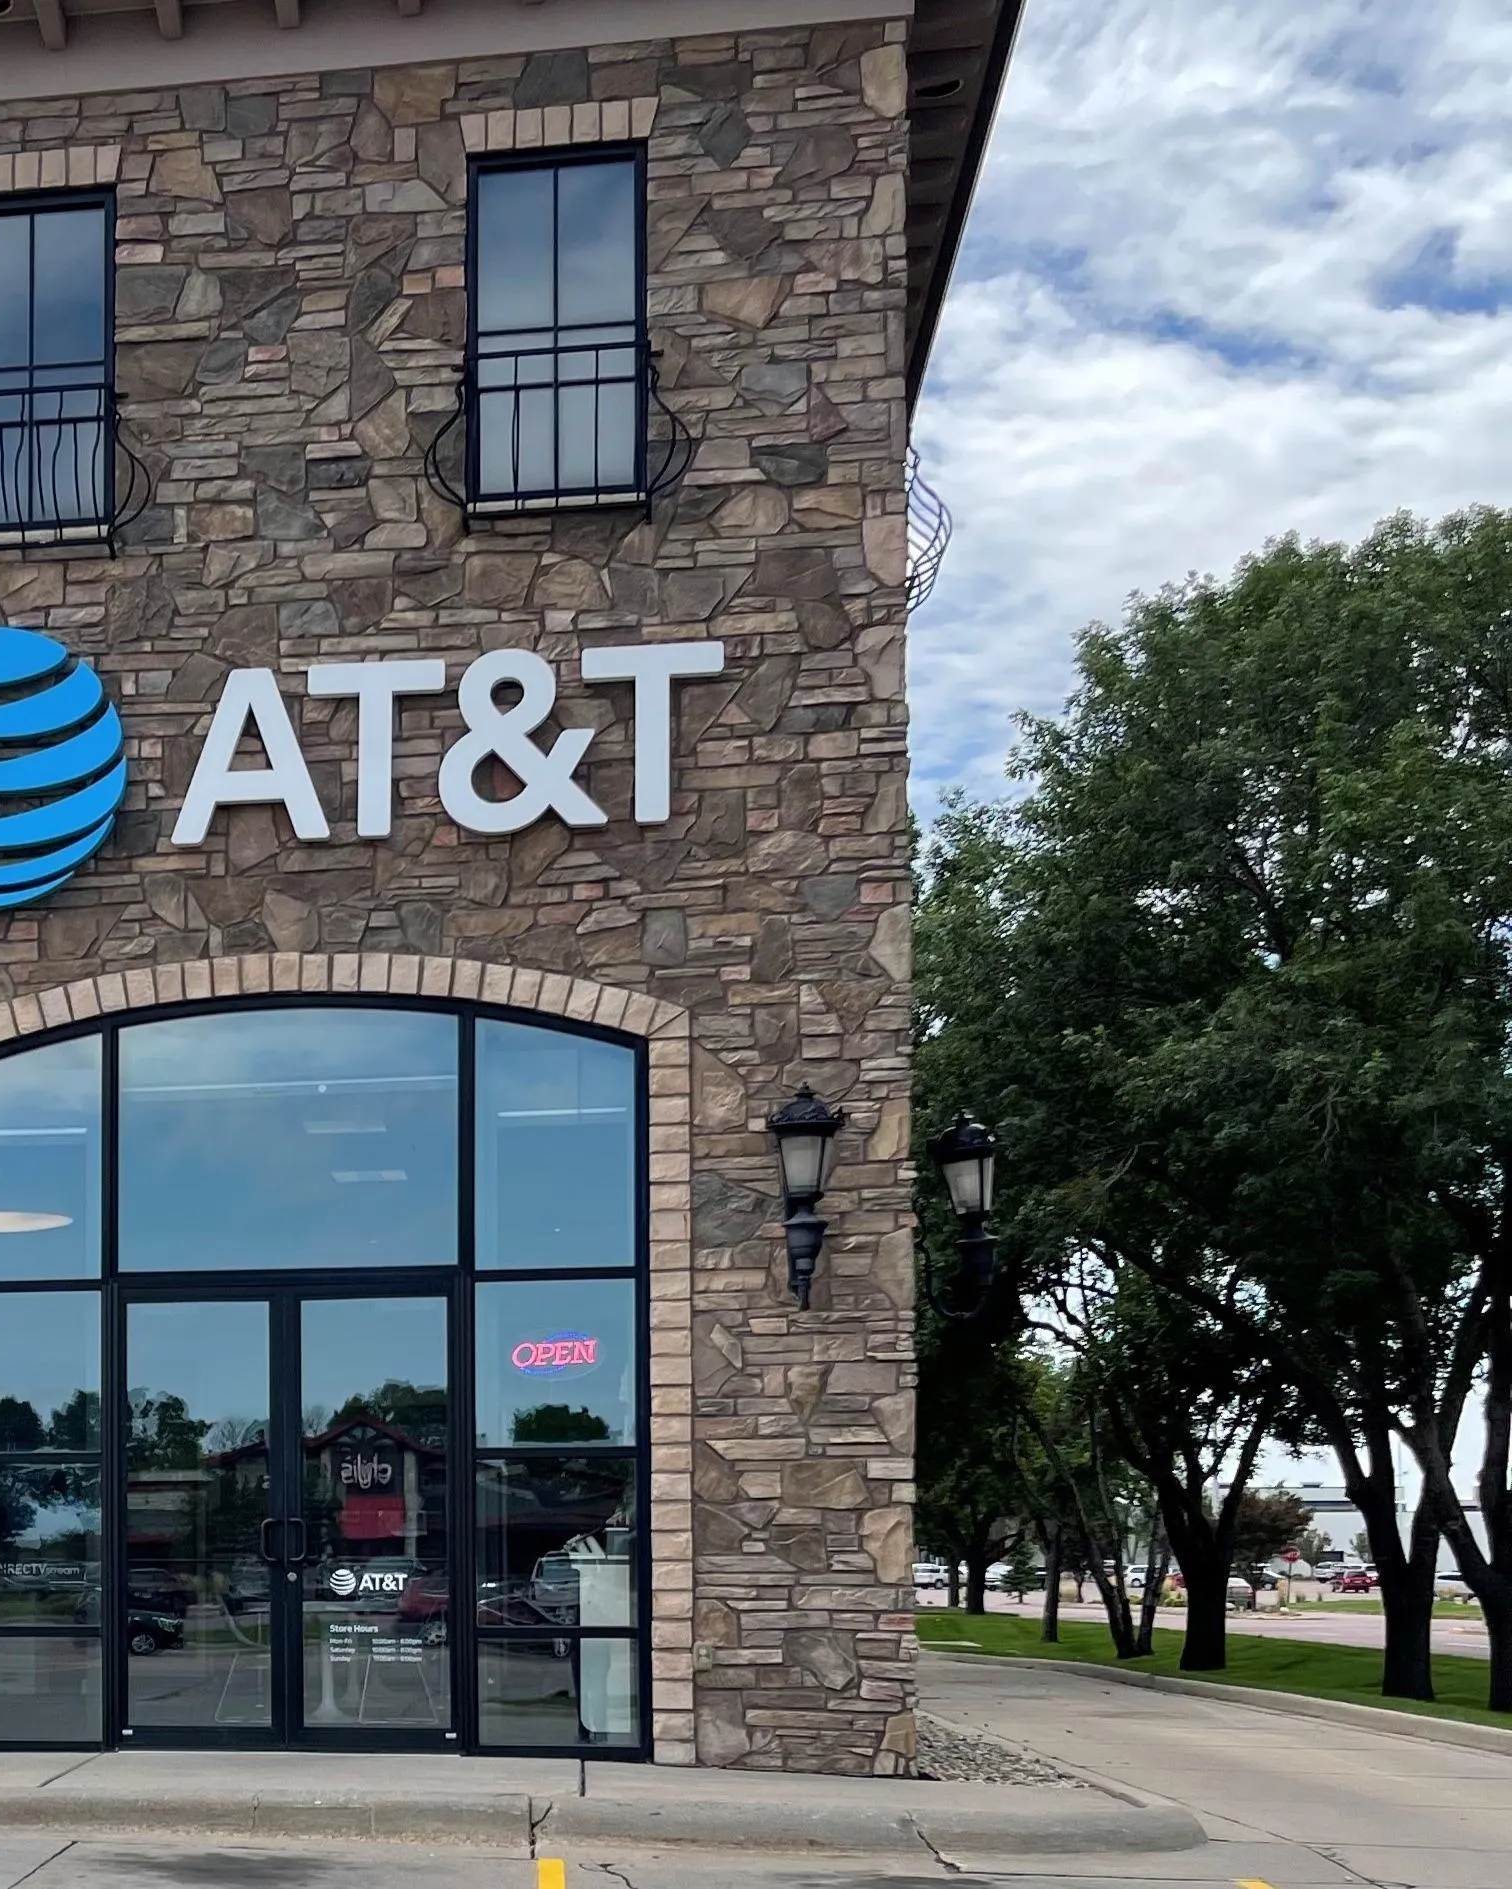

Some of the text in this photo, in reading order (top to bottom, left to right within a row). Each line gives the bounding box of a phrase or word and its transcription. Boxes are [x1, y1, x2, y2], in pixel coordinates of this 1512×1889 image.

[170, 641, 725, 847] AT&T
[512, 1339, 597, 1368] OPEN
[358, 1573, 408, 1591] AT&T
[329, 1624, 378, 1633] Store Hours
